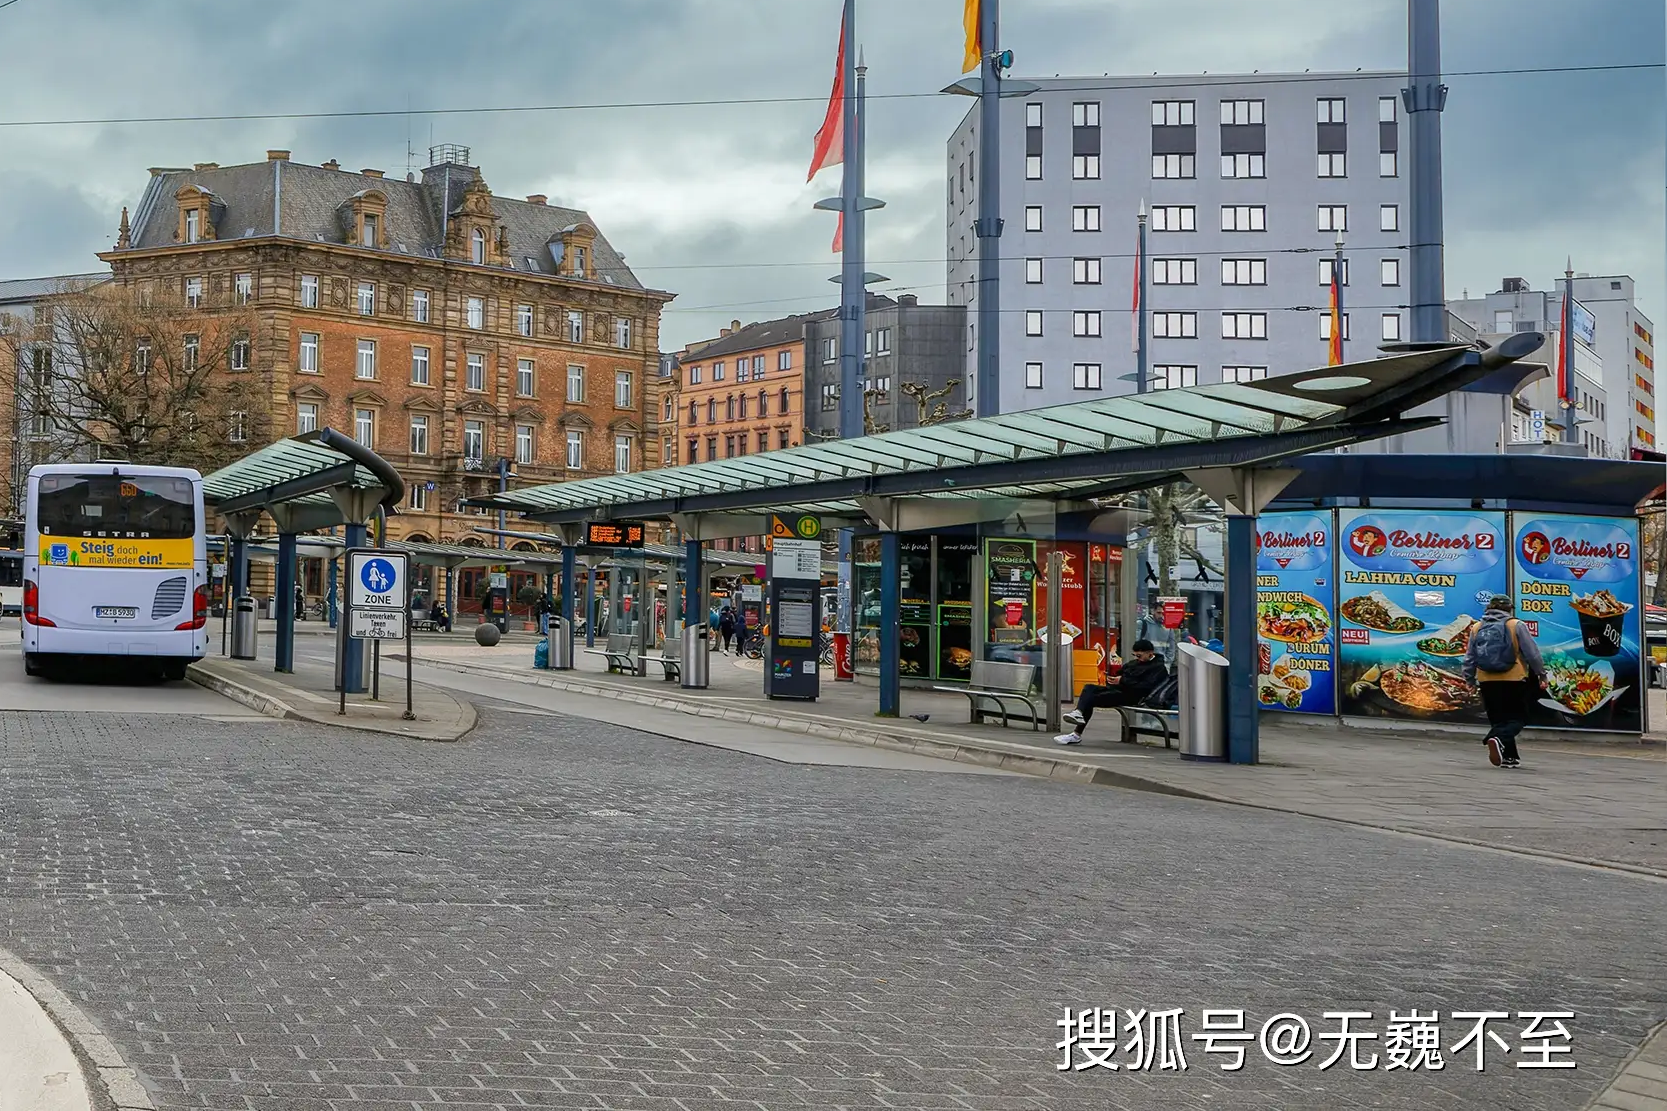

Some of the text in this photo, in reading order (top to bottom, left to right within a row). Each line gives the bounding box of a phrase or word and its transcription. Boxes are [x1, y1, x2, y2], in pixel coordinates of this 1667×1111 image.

[1533, 411, 1542, 438] HOT
[1263, 530, 1325, 548] Berliner 2
[1388, 529, 1493, 549] Berliner 2
[81, 540, 138, 557] Steig doch
[1552, 536, 1629, 559] Berliner 2
[89, 556, 105, 564] mal
[107, 556, 136, 564] wieder
[138, 552, 163, 565] ein!
[991, 556, 1031, 564] SMASHERIA
[1257, 575, 1279, 587] NER
[1345, 571, 1456, 587] LAHMACUN
[1521, 580, 1571, 596] DÖNER
[365, 594, 391, 604] ZONE
[1257, 592, 1303, 602] NDWICH
[1521, 599, 1553, 613] BOX
[360, 612, 397, 621] Linienverkehr,
[371, 620, 386, 628] Taxen
[1525, 621, 1538, 636] EU!
[387, 630, 397, 638] frei
[1342, 630, 1369, 643] NEU!
[1603, 623, 1621, 648] BOX
[1290, 657, 1330, 671] DÖNER
